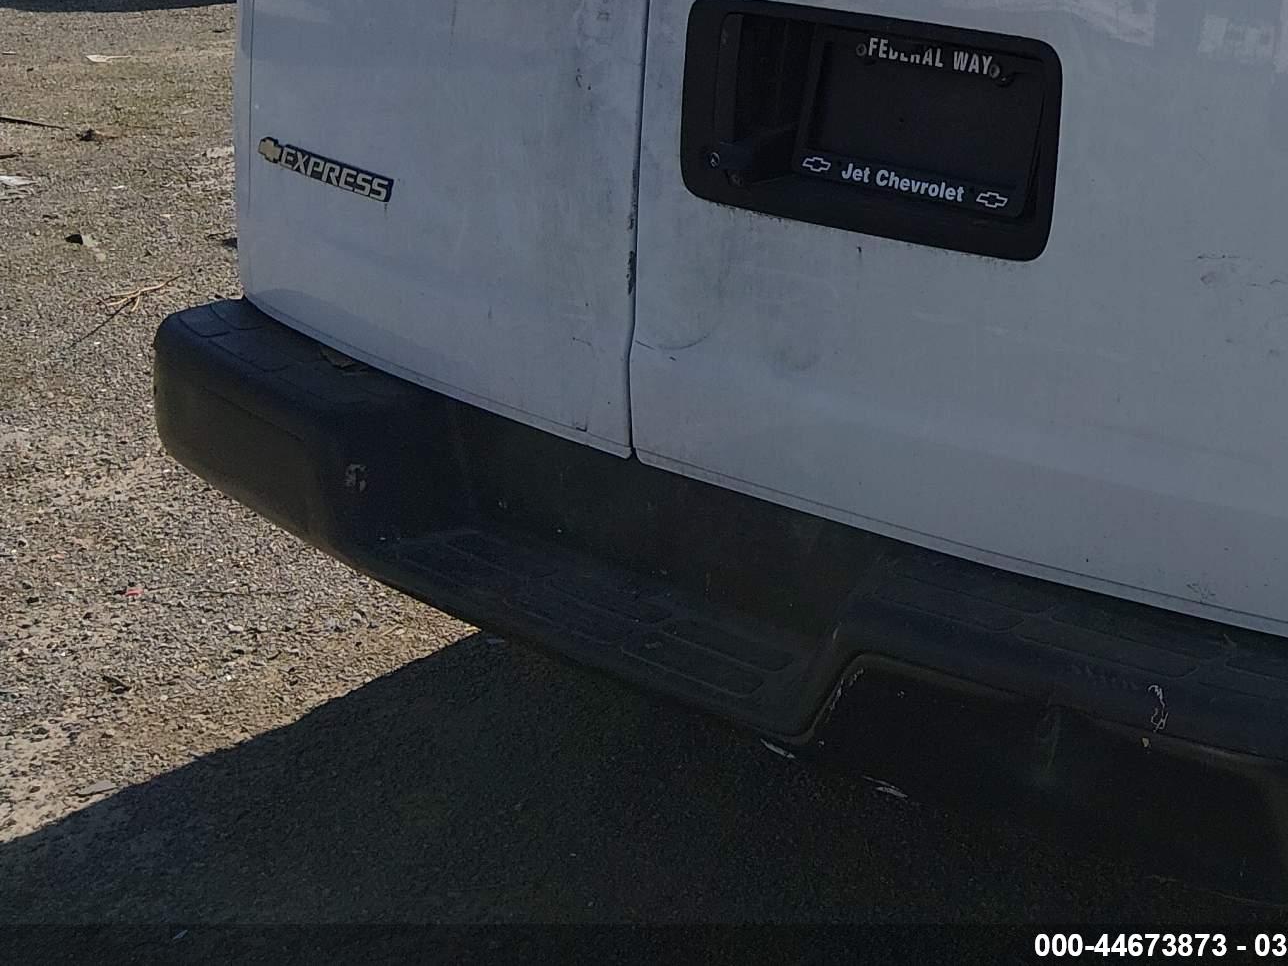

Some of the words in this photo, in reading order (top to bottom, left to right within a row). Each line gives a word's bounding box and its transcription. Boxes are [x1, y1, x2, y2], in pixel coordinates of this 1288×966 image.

[953, 50, 993, 75] WAY
[280, 145, 390, 202] EXPRESS
[841, 163, 871, 184] Jet
[875, 169, 965, 202] Chevrolet
